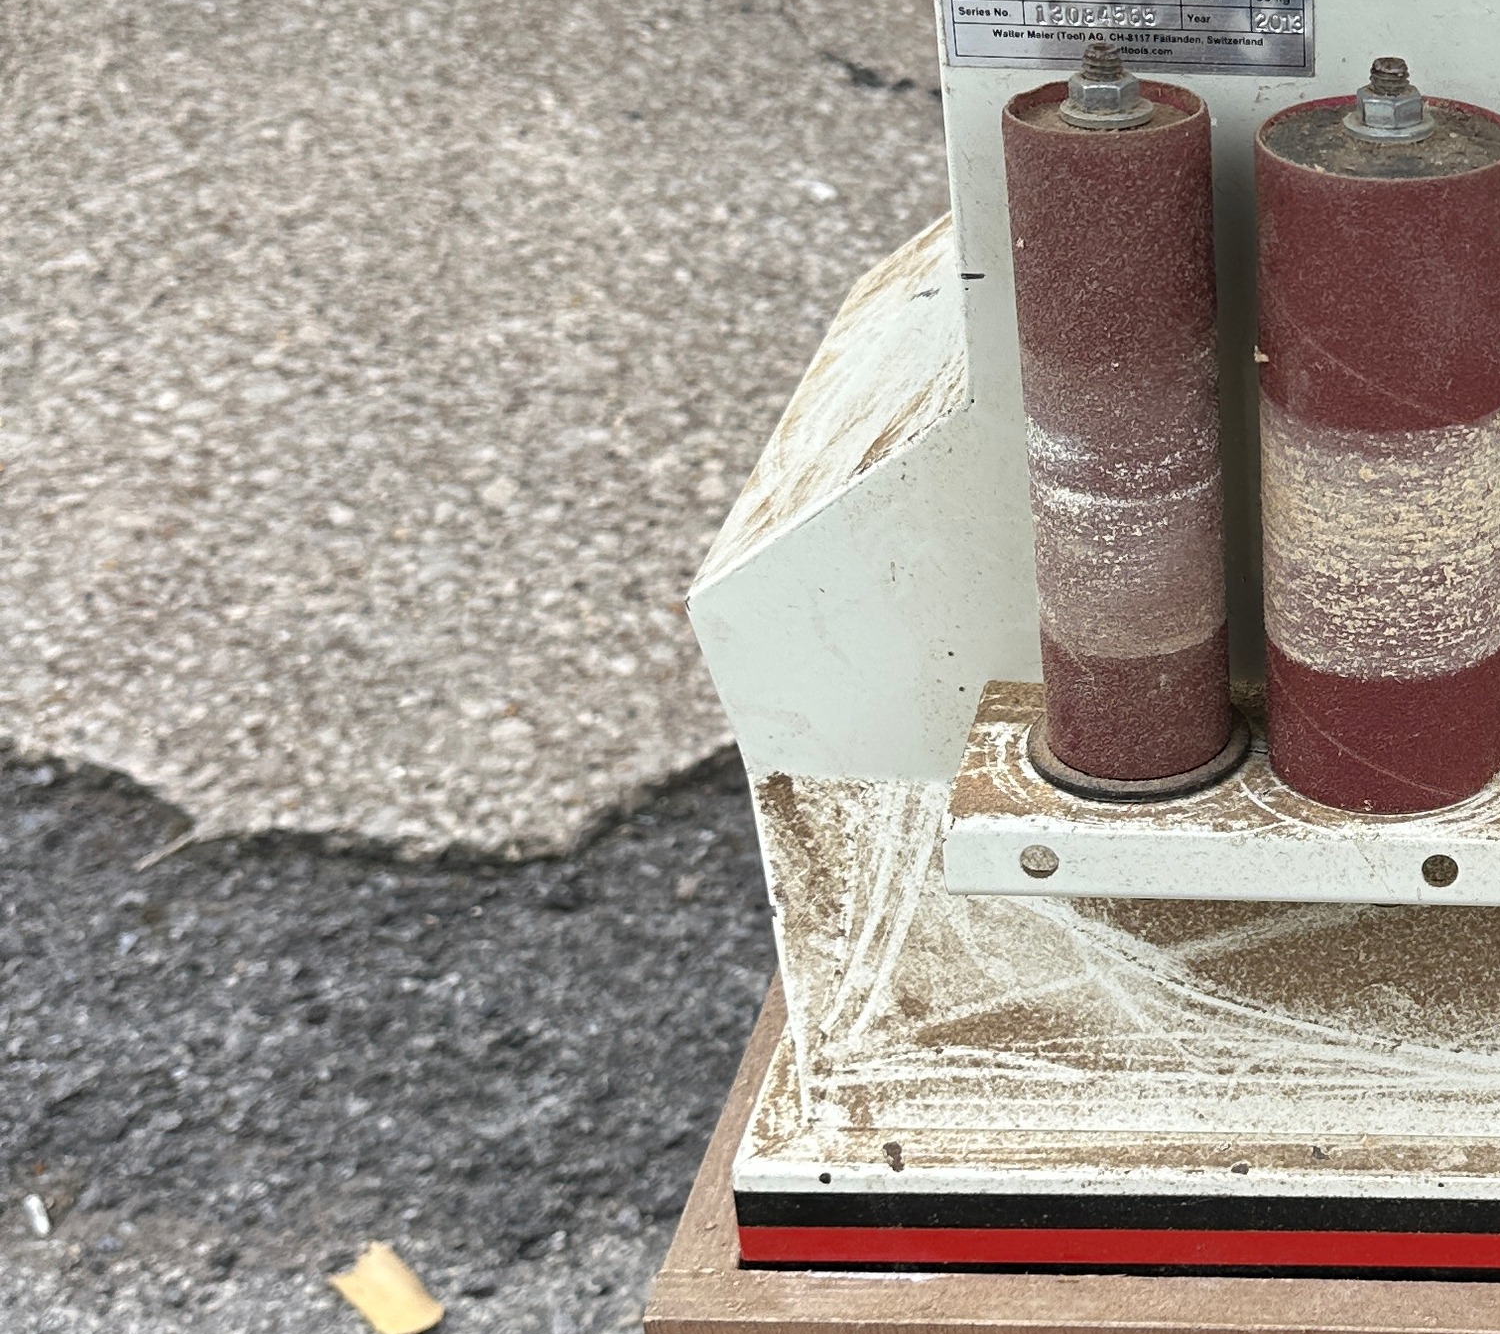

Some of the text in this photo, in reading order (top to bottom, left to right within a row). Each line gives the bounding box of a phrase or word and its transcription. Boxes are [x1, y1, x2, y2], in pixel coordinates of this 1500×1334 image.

[958, 6, 1011, 17] Series No.
[1187, 13, 1211, 24] Year
[1254, 12, 1304, 34] 2013
[1057, 30, 1086, 43] (Tool)
[1109, 33, 1150, 44] CH-8117
[1206, 35, 1264, 47] Switzerland
[1118, 46, 1173, 56] ttools.com
